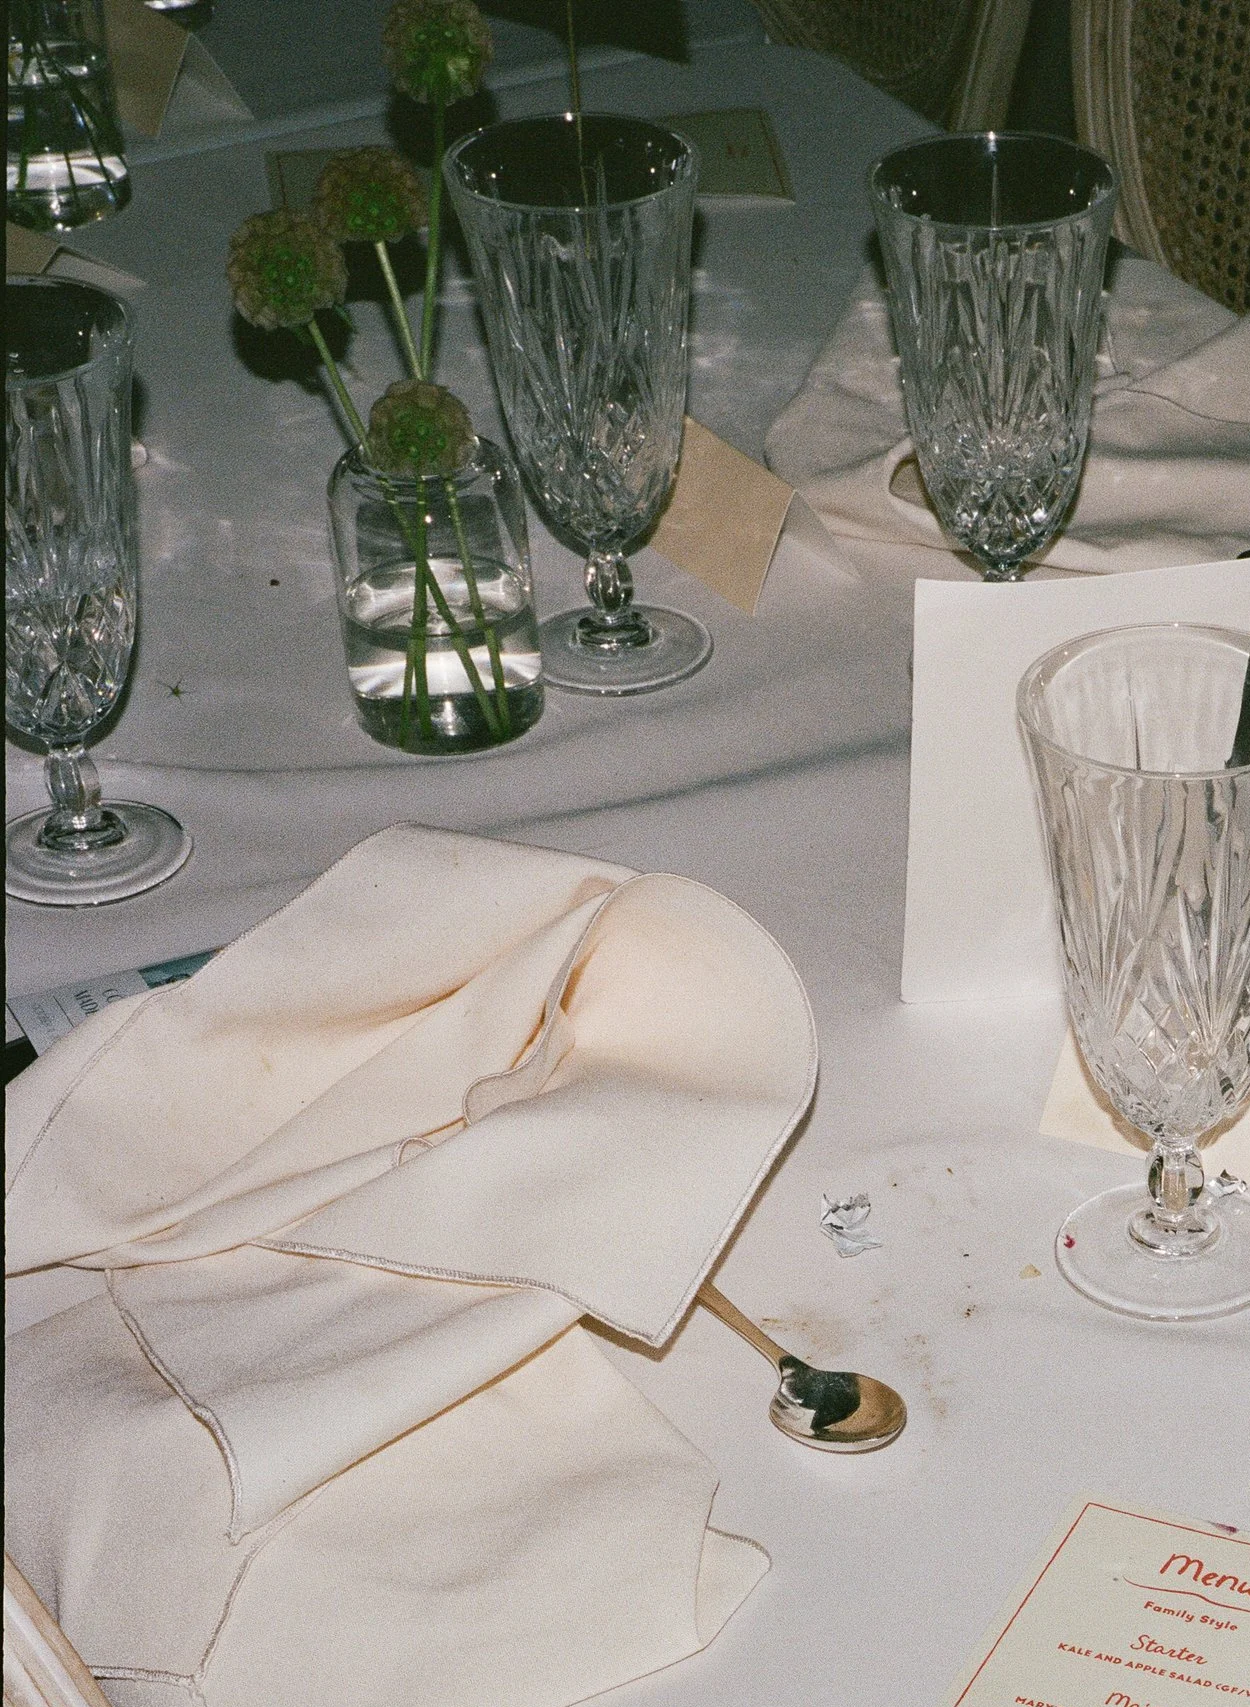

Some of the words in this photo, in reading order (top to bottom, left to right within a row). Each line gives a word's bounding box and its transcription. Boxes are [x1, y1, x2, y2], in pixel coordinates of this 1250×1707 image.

[1144, 1600, 1196, 1623] Family
[1200, 1615, 1239, 1631] Style
[1057, 1642, 1092, 1657] KALE
[1094, 1652, 1123, 1664] AND
[1125, 1660, 1166, 1676] APPLE
[1168, 1671, 1215, 1688] SALAD
[1129, 1634, 1206, 1665] Starter
